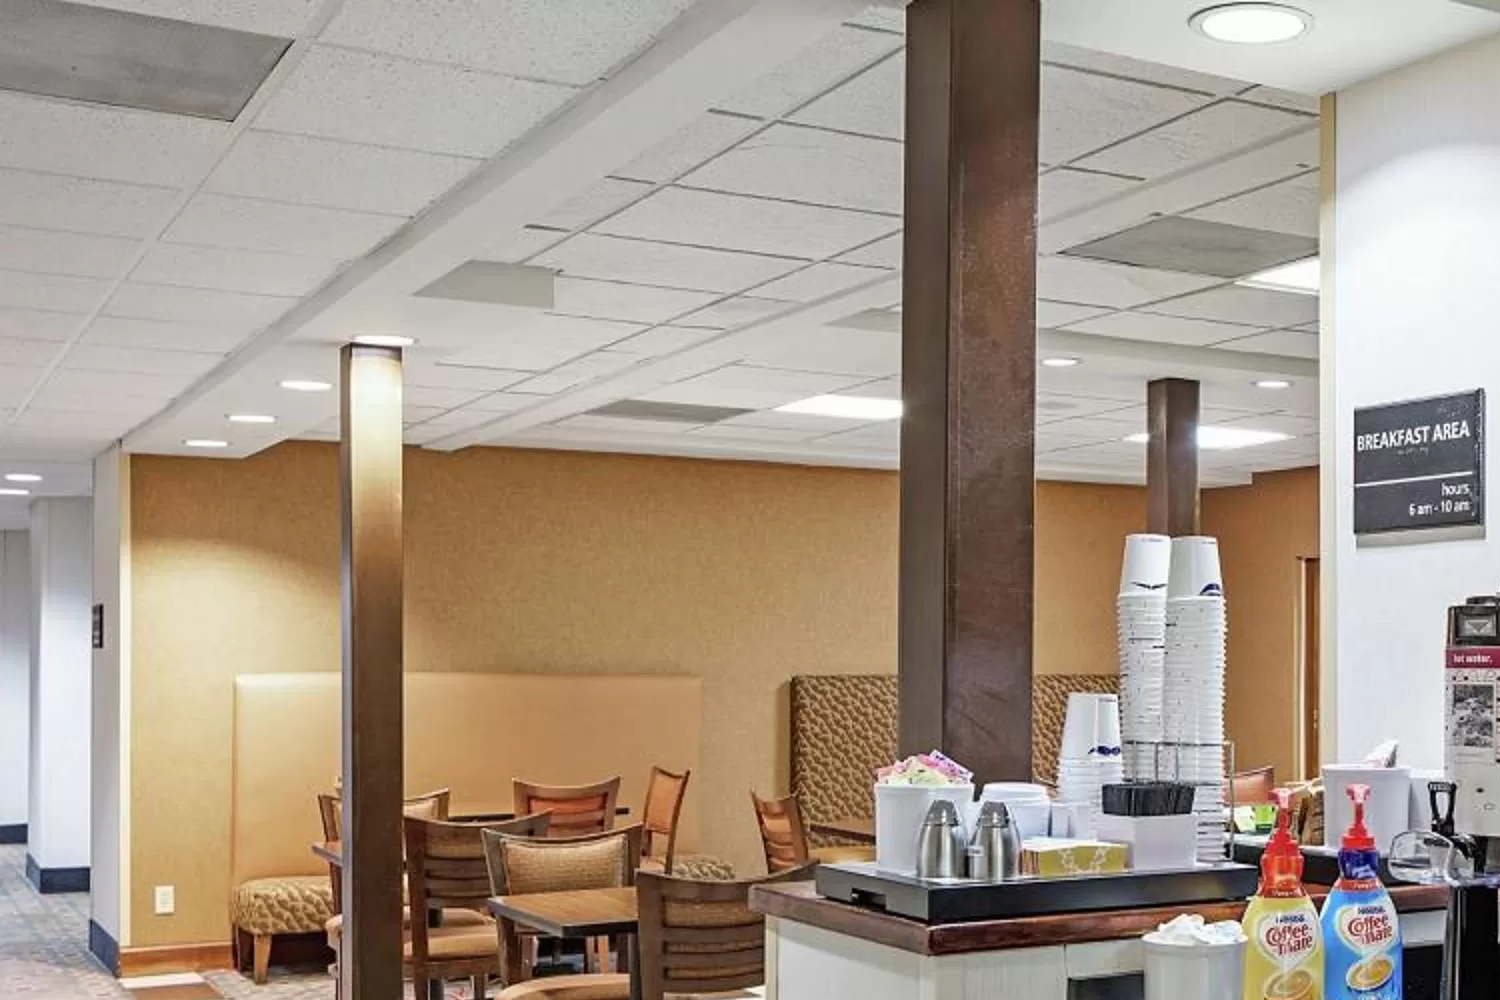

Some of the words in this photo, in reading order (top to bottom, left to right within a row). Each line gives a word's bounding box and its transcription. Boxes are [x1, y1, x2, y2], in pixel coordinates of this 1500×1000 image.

[1357, 425, 1430, 451] BREAKFAST
[1432, 420, 1471, 442] AREA
[1441, 500, 1452, 513] 10
